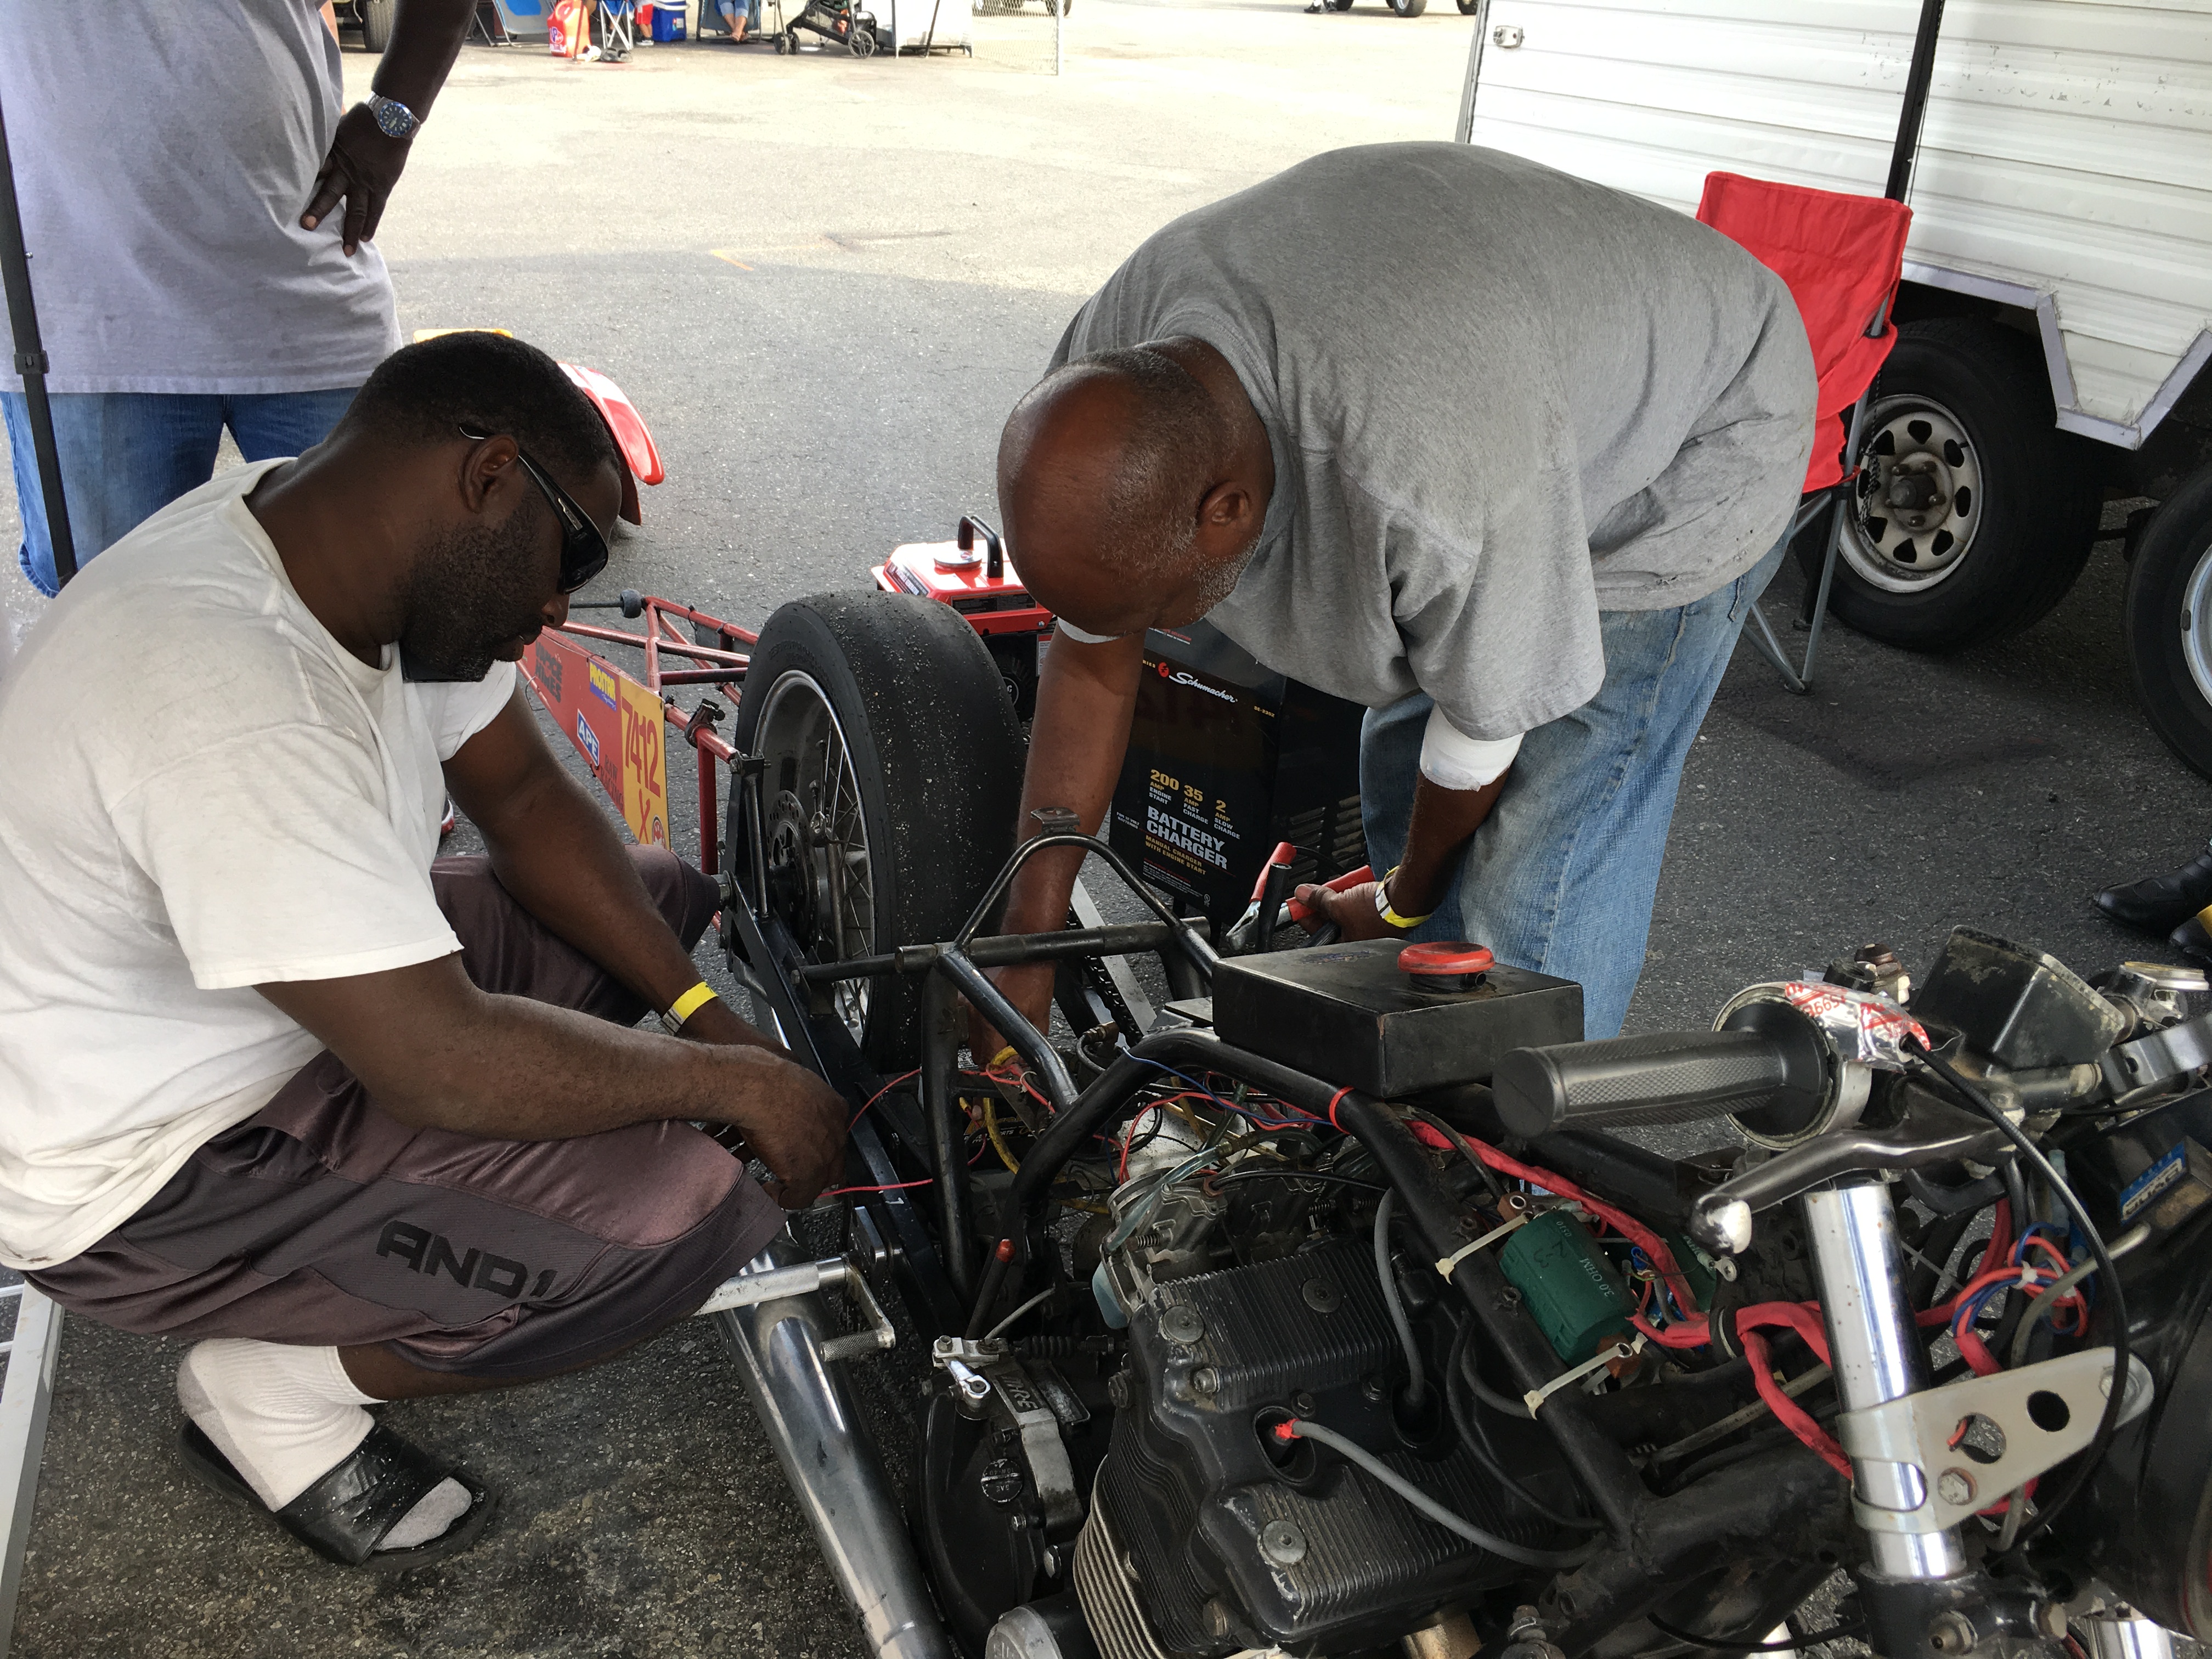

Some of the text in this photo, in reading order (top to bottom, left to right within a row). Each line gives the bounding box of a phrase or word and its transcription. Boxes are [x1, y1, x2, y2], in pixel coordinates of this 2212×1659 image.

[1142, 659, 1156, 668] RIES
[1169, 672, 1236, 703] Schumacher
[578, 720, 598, 761] APE
[622, 696, 661, 799] 7412
[1150, 769, 1180, 791] 200
[1150, 781, 1165, 791] AMP
[1149, 786, 1172, 801] ENGINE
[1149, 792, 1169, 805] START
[1183, 785, 1203, 802] 35
[1183, 803, 1200, 814] FAST
[1184, 798, 1199, 807] AMP
[1215, 799, 1227, 814] 2
[1183, 808, 1209, 825] CHARGE
[1214, 817, 1233, 830] SLOW
[1215, 812, 1231, 822] AMP
[1148, 805, 1225, 851] BATTERY
[1214, 823, 1240, 840] CHARGE
[1146, 820, 1227, 870] CHARGER
[1146, 835, 1202, 867] MANUAL CHARGER
[1146, 841, 1161, 852] WITH
[1163, 849, 1185, 864] ENGINE
[1186, 861, 1206, 875] START
[1556, 1221, 1572, 1237] 0510
[1579, 1257, 1615, 1297] 3.0 OHM
[996, 1483, 1010, 1493] SAE
